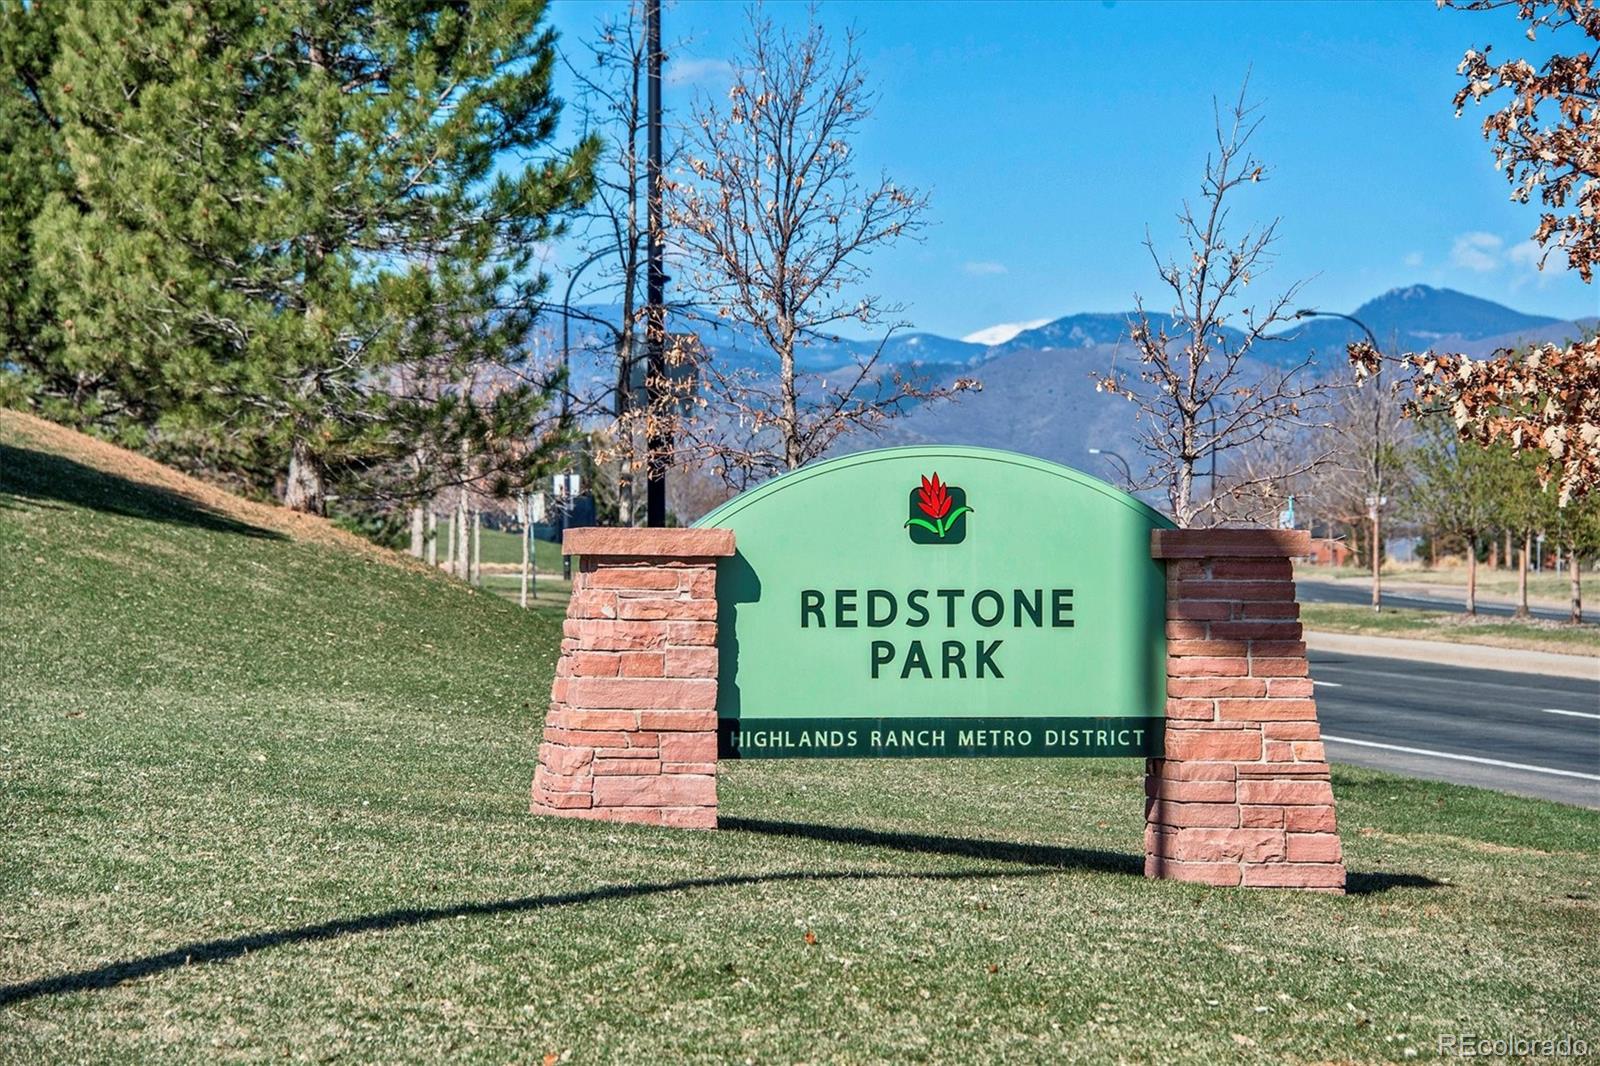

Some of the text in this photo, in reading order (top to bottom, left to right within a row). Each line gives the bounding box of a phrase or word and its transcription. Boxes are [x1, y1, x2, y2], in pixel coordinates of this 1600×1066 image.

[800, 588, 1076, 629] REDSTONE
[870, 639, 1005, 680] PARK
[730, 729, 1146, 748] HIGHLANDS RANCH METRO DISTRICT
